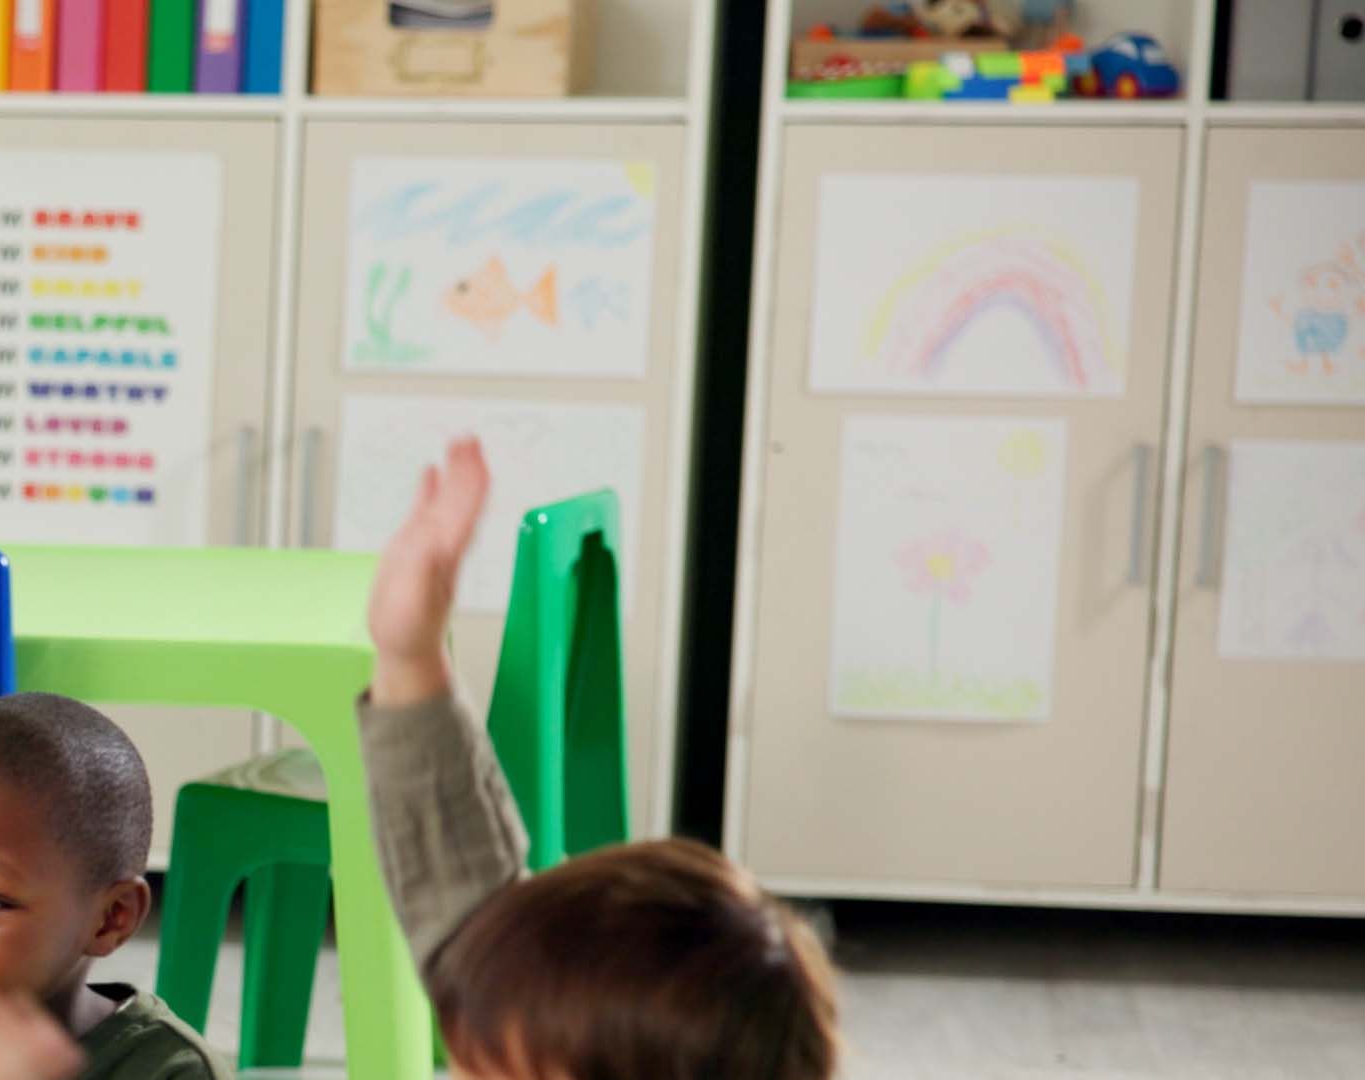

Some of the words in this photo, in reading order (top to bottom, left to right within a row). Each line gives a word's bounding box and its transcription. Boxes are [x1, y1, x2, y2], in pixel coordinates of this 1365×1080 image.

[33, 208, 141, 231] BRAVE
[31, 243, 110, 265] KIND
[29, 278, 143, 299] SMART
[28, 312, 171, 335] HELPFUL
[28, 347, 178, 369] CAPABLE
[27, 382, 169, 402] WORTHY
[24, 415, 131, 436] LOVED
[24, 449, 156, 472] STRONG
